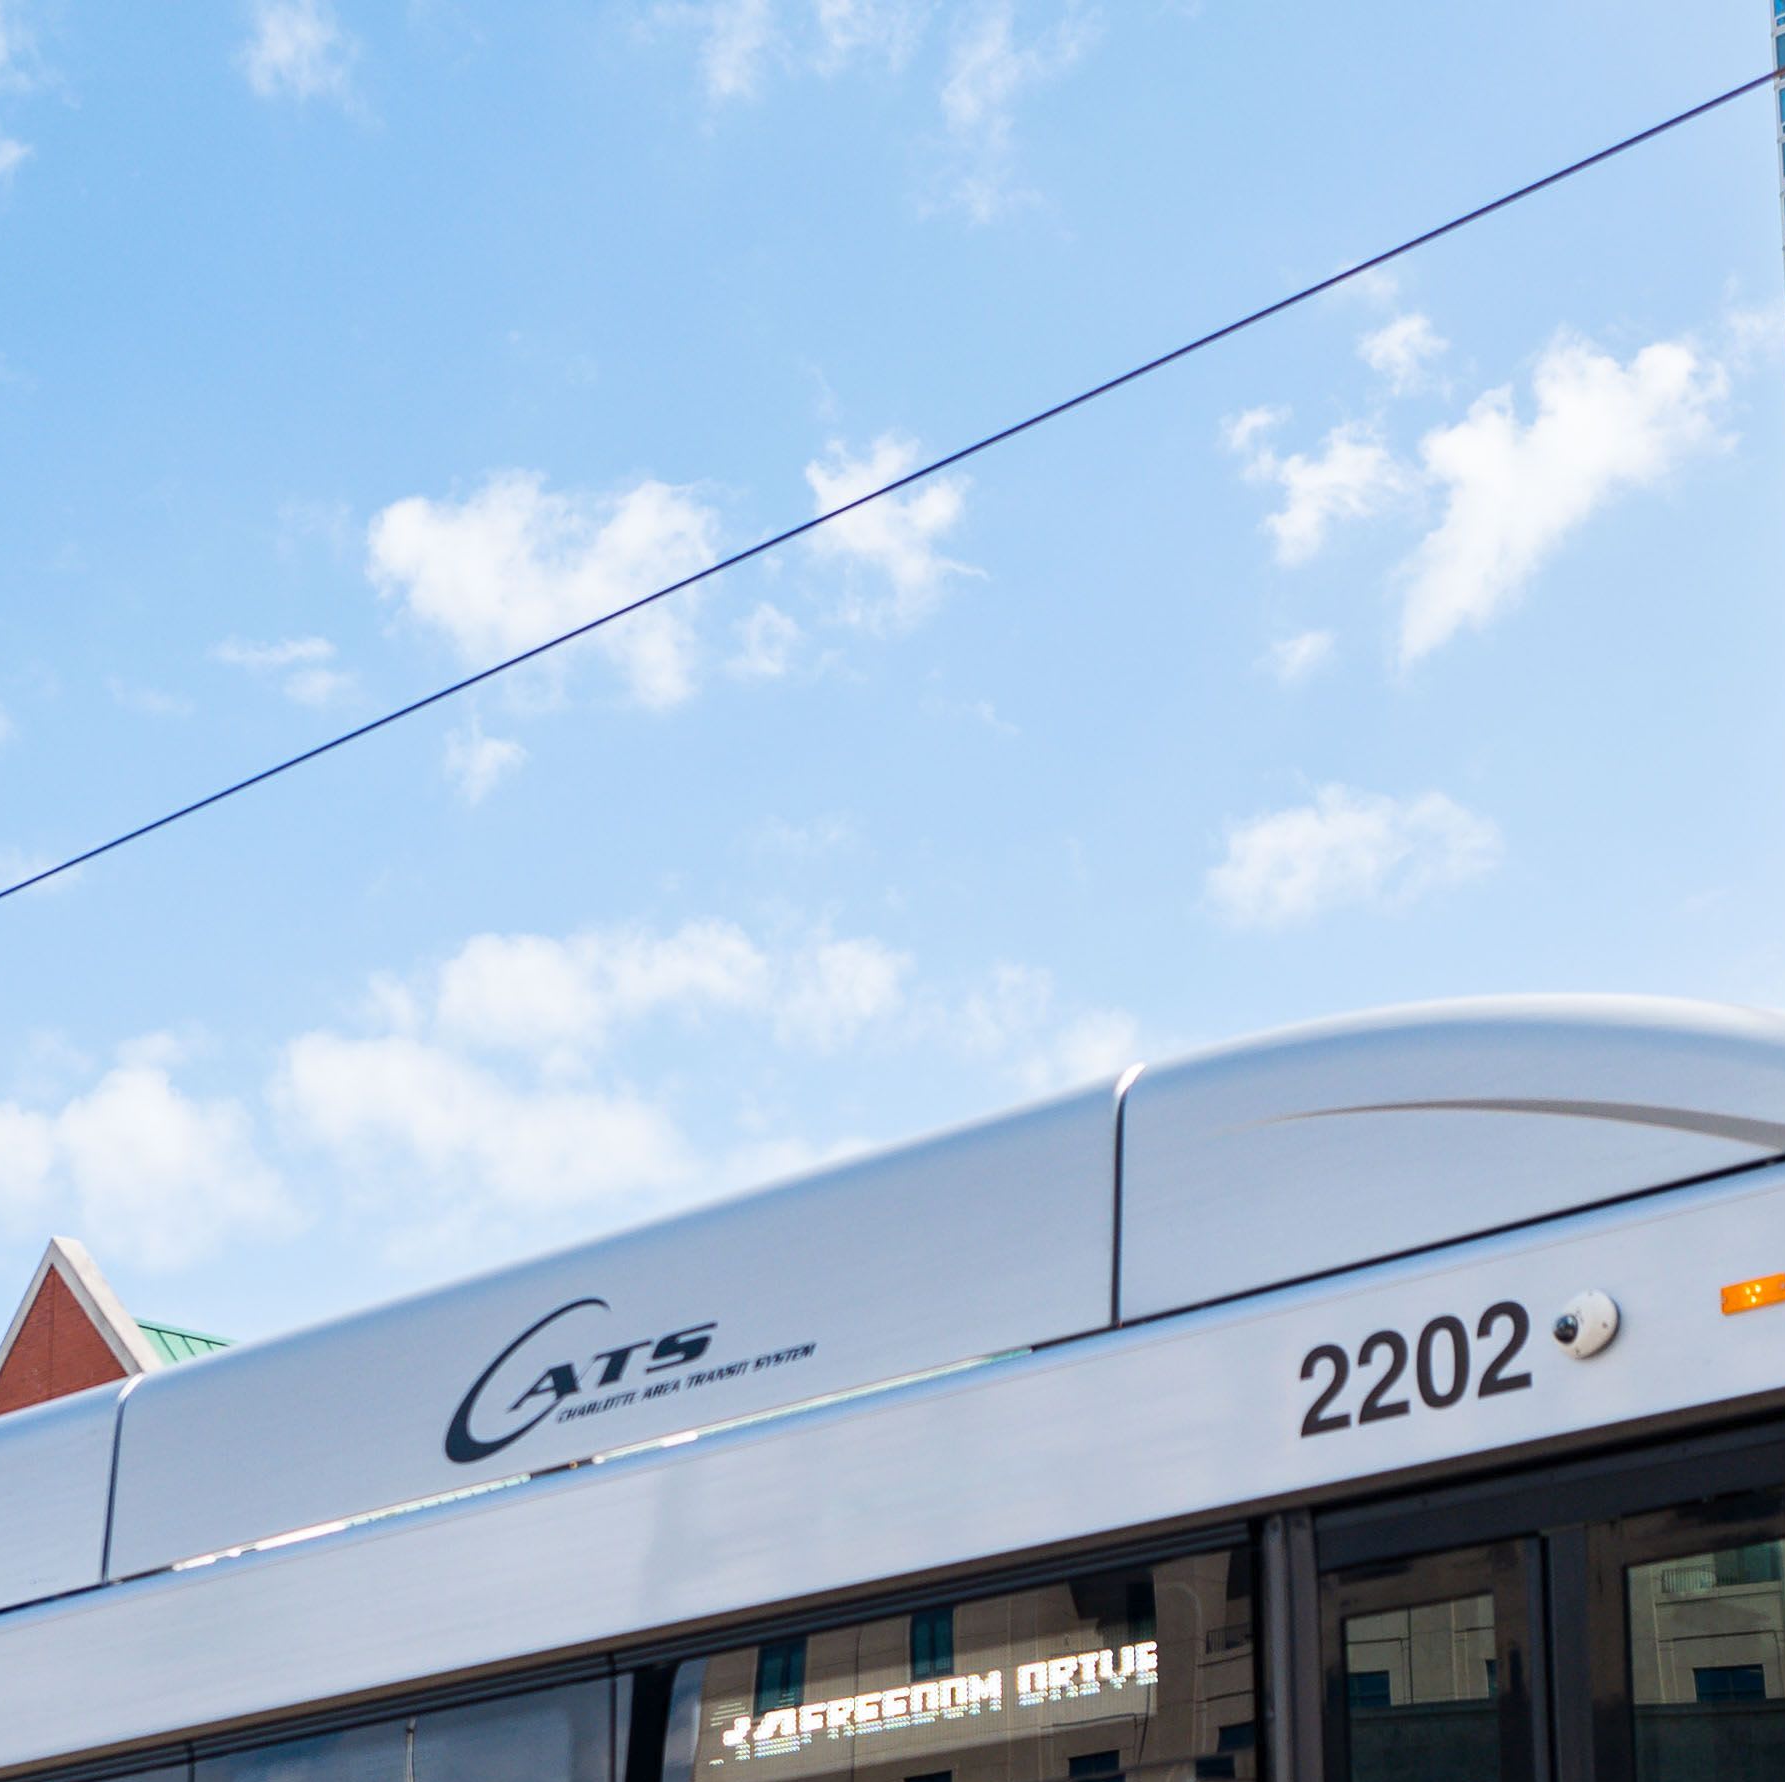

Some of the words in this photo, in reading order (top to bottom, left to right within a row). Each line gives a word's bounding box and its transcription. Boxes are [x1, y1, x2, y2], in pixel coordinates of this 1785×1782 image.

[445, 1298, 719, 1463] CATS
[557, 1392, 636, 1424] CHARLOTTE
[641, 1379, 681, 1401] AREA
[686, 1364, 748, 1390] TRANSIT
[752, 1342, 817, 1373] SYSTEM
[1299, 1300, 1532, 1438] 2202
